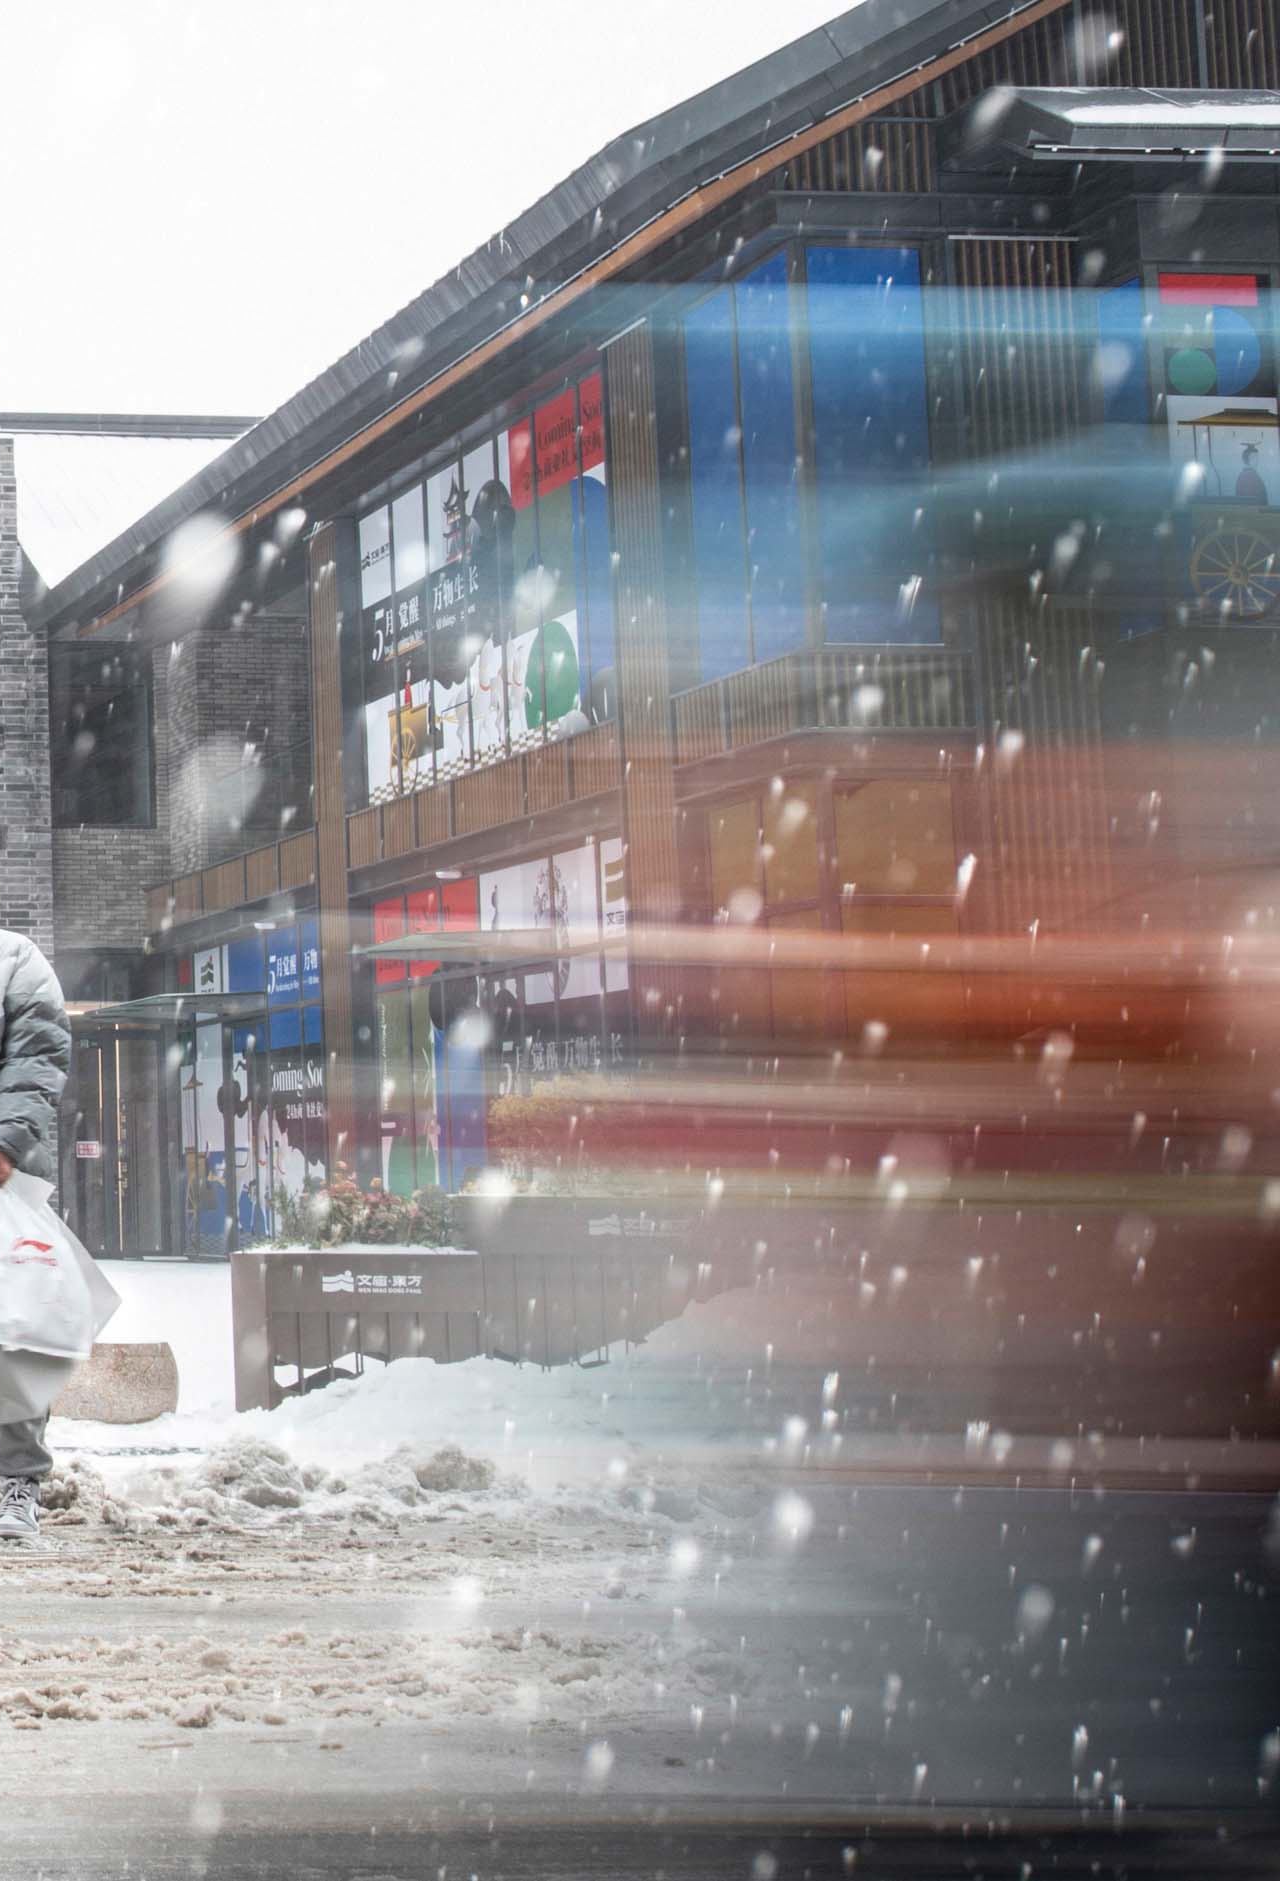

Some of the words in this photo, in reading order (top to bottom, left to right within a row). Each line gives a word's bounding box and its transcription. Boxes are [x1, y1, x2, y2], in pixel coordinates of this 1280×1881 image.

[432, 565, 479, 614] 万物生长
[271, 1062, 303, 1097] oming
